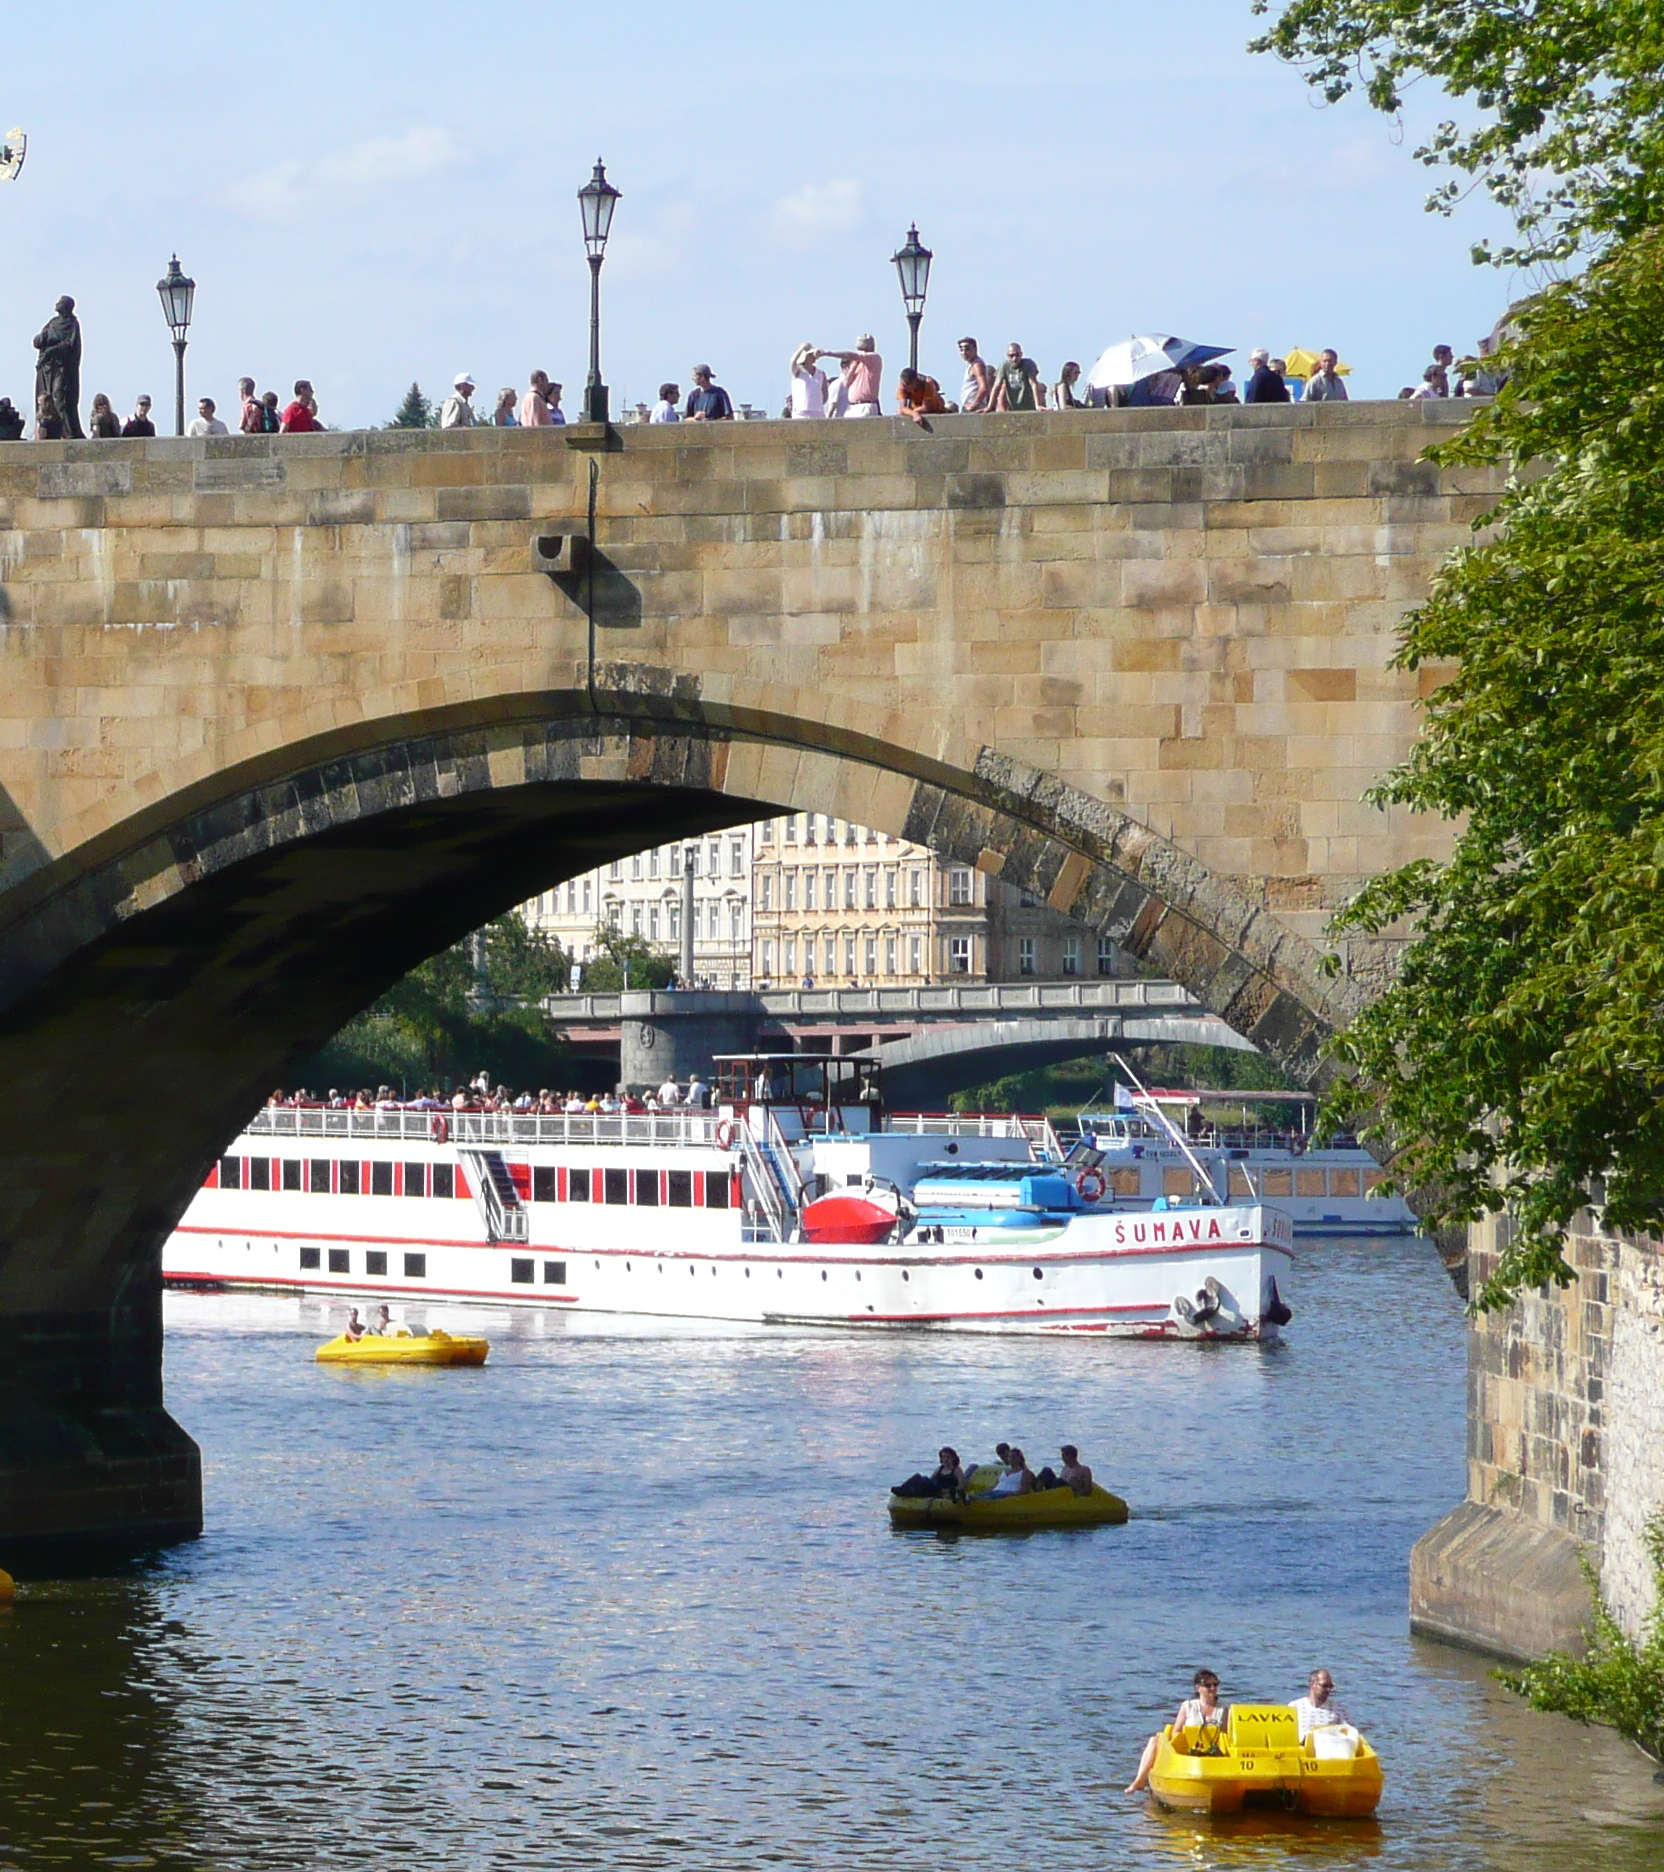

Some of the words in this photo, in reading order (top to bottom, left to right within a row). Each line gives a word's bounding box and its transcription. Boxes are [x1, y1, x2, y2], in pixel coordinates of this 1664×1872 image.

[1115, 1218, 1221, 1244] ŠUMAVA
[1237, 1713, 1295, 1723] LAVKA
[1239, 1760, 1255, 1771] 10
[1303, 1760, 1319, 1772] 10
